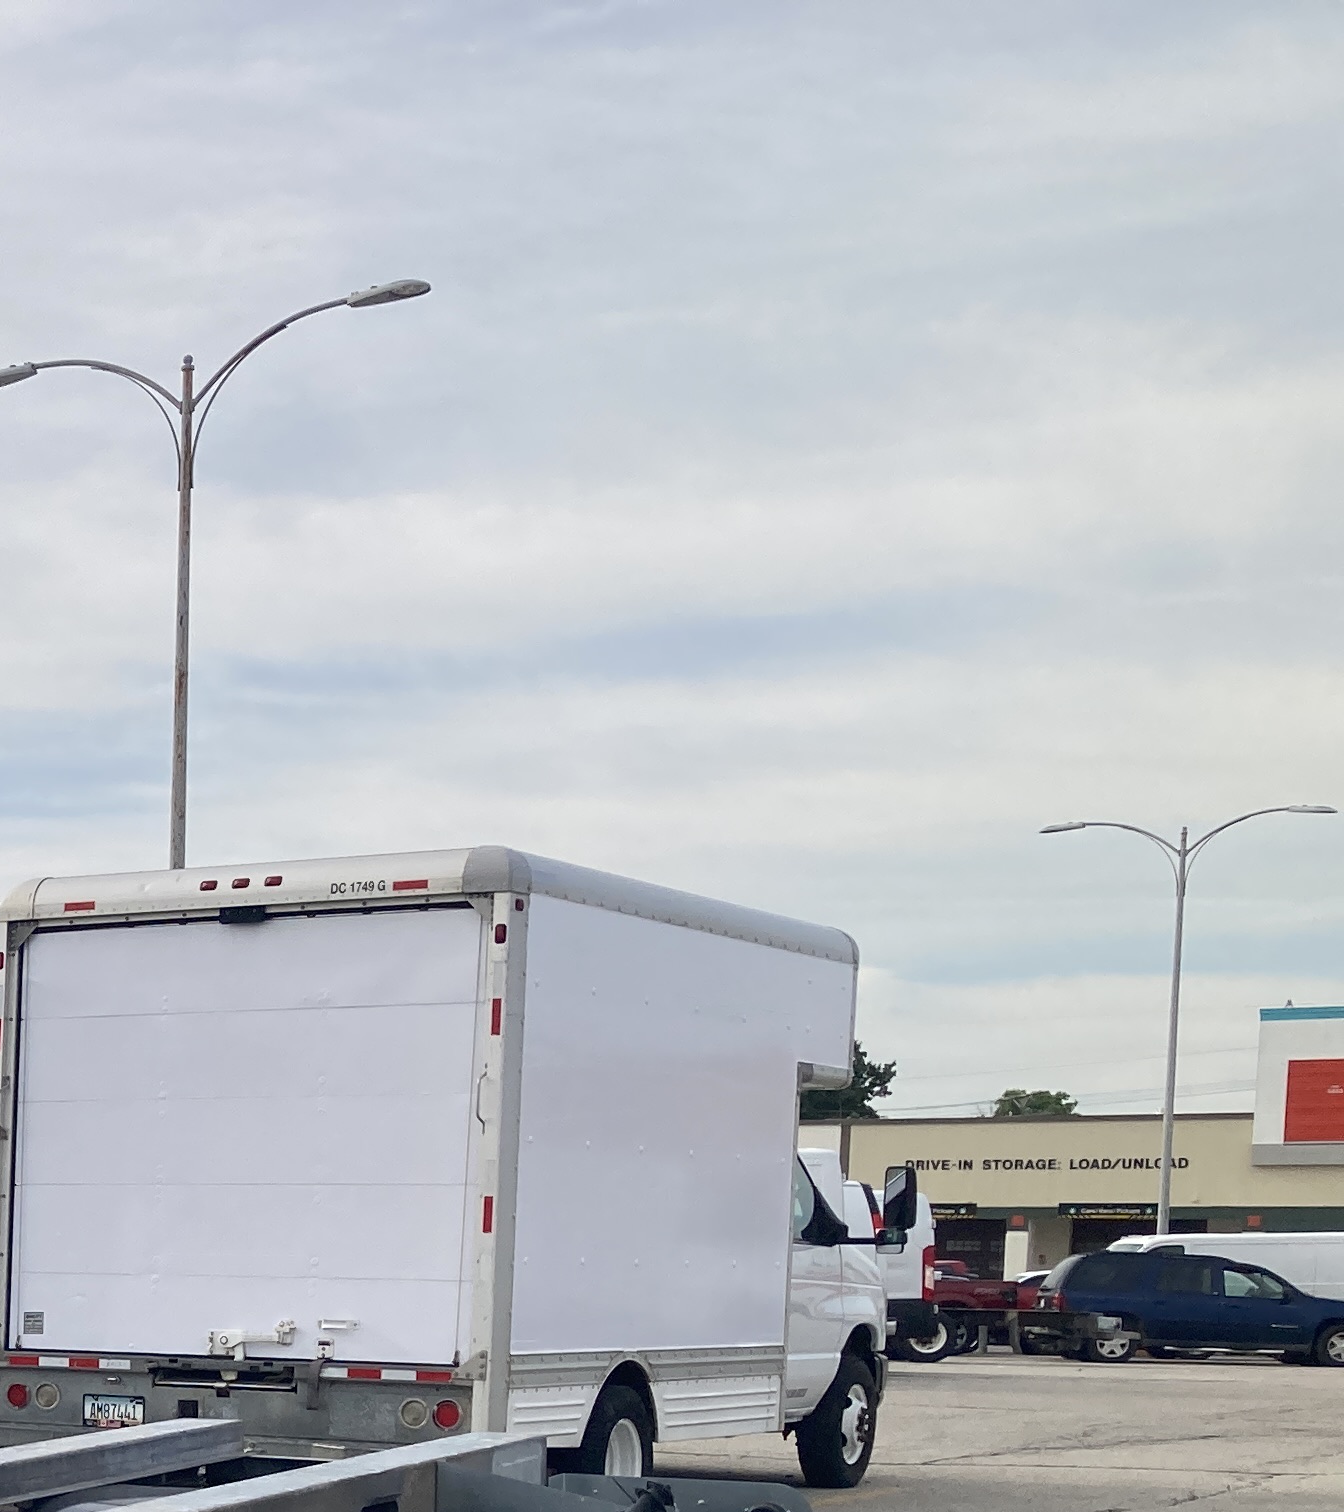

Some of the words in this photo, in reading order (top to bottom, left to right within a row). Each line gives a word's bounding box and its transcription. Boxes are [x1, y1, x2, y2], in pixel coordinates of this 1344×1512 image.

[330, 882, 347, 895] DC
[350, 880, 375, 893] 1749
[377, 879, 386, 892] G
[905, 1159, 973, 1171] DRIVE-IN
[89, 1402, 137, 1420] AM87441
